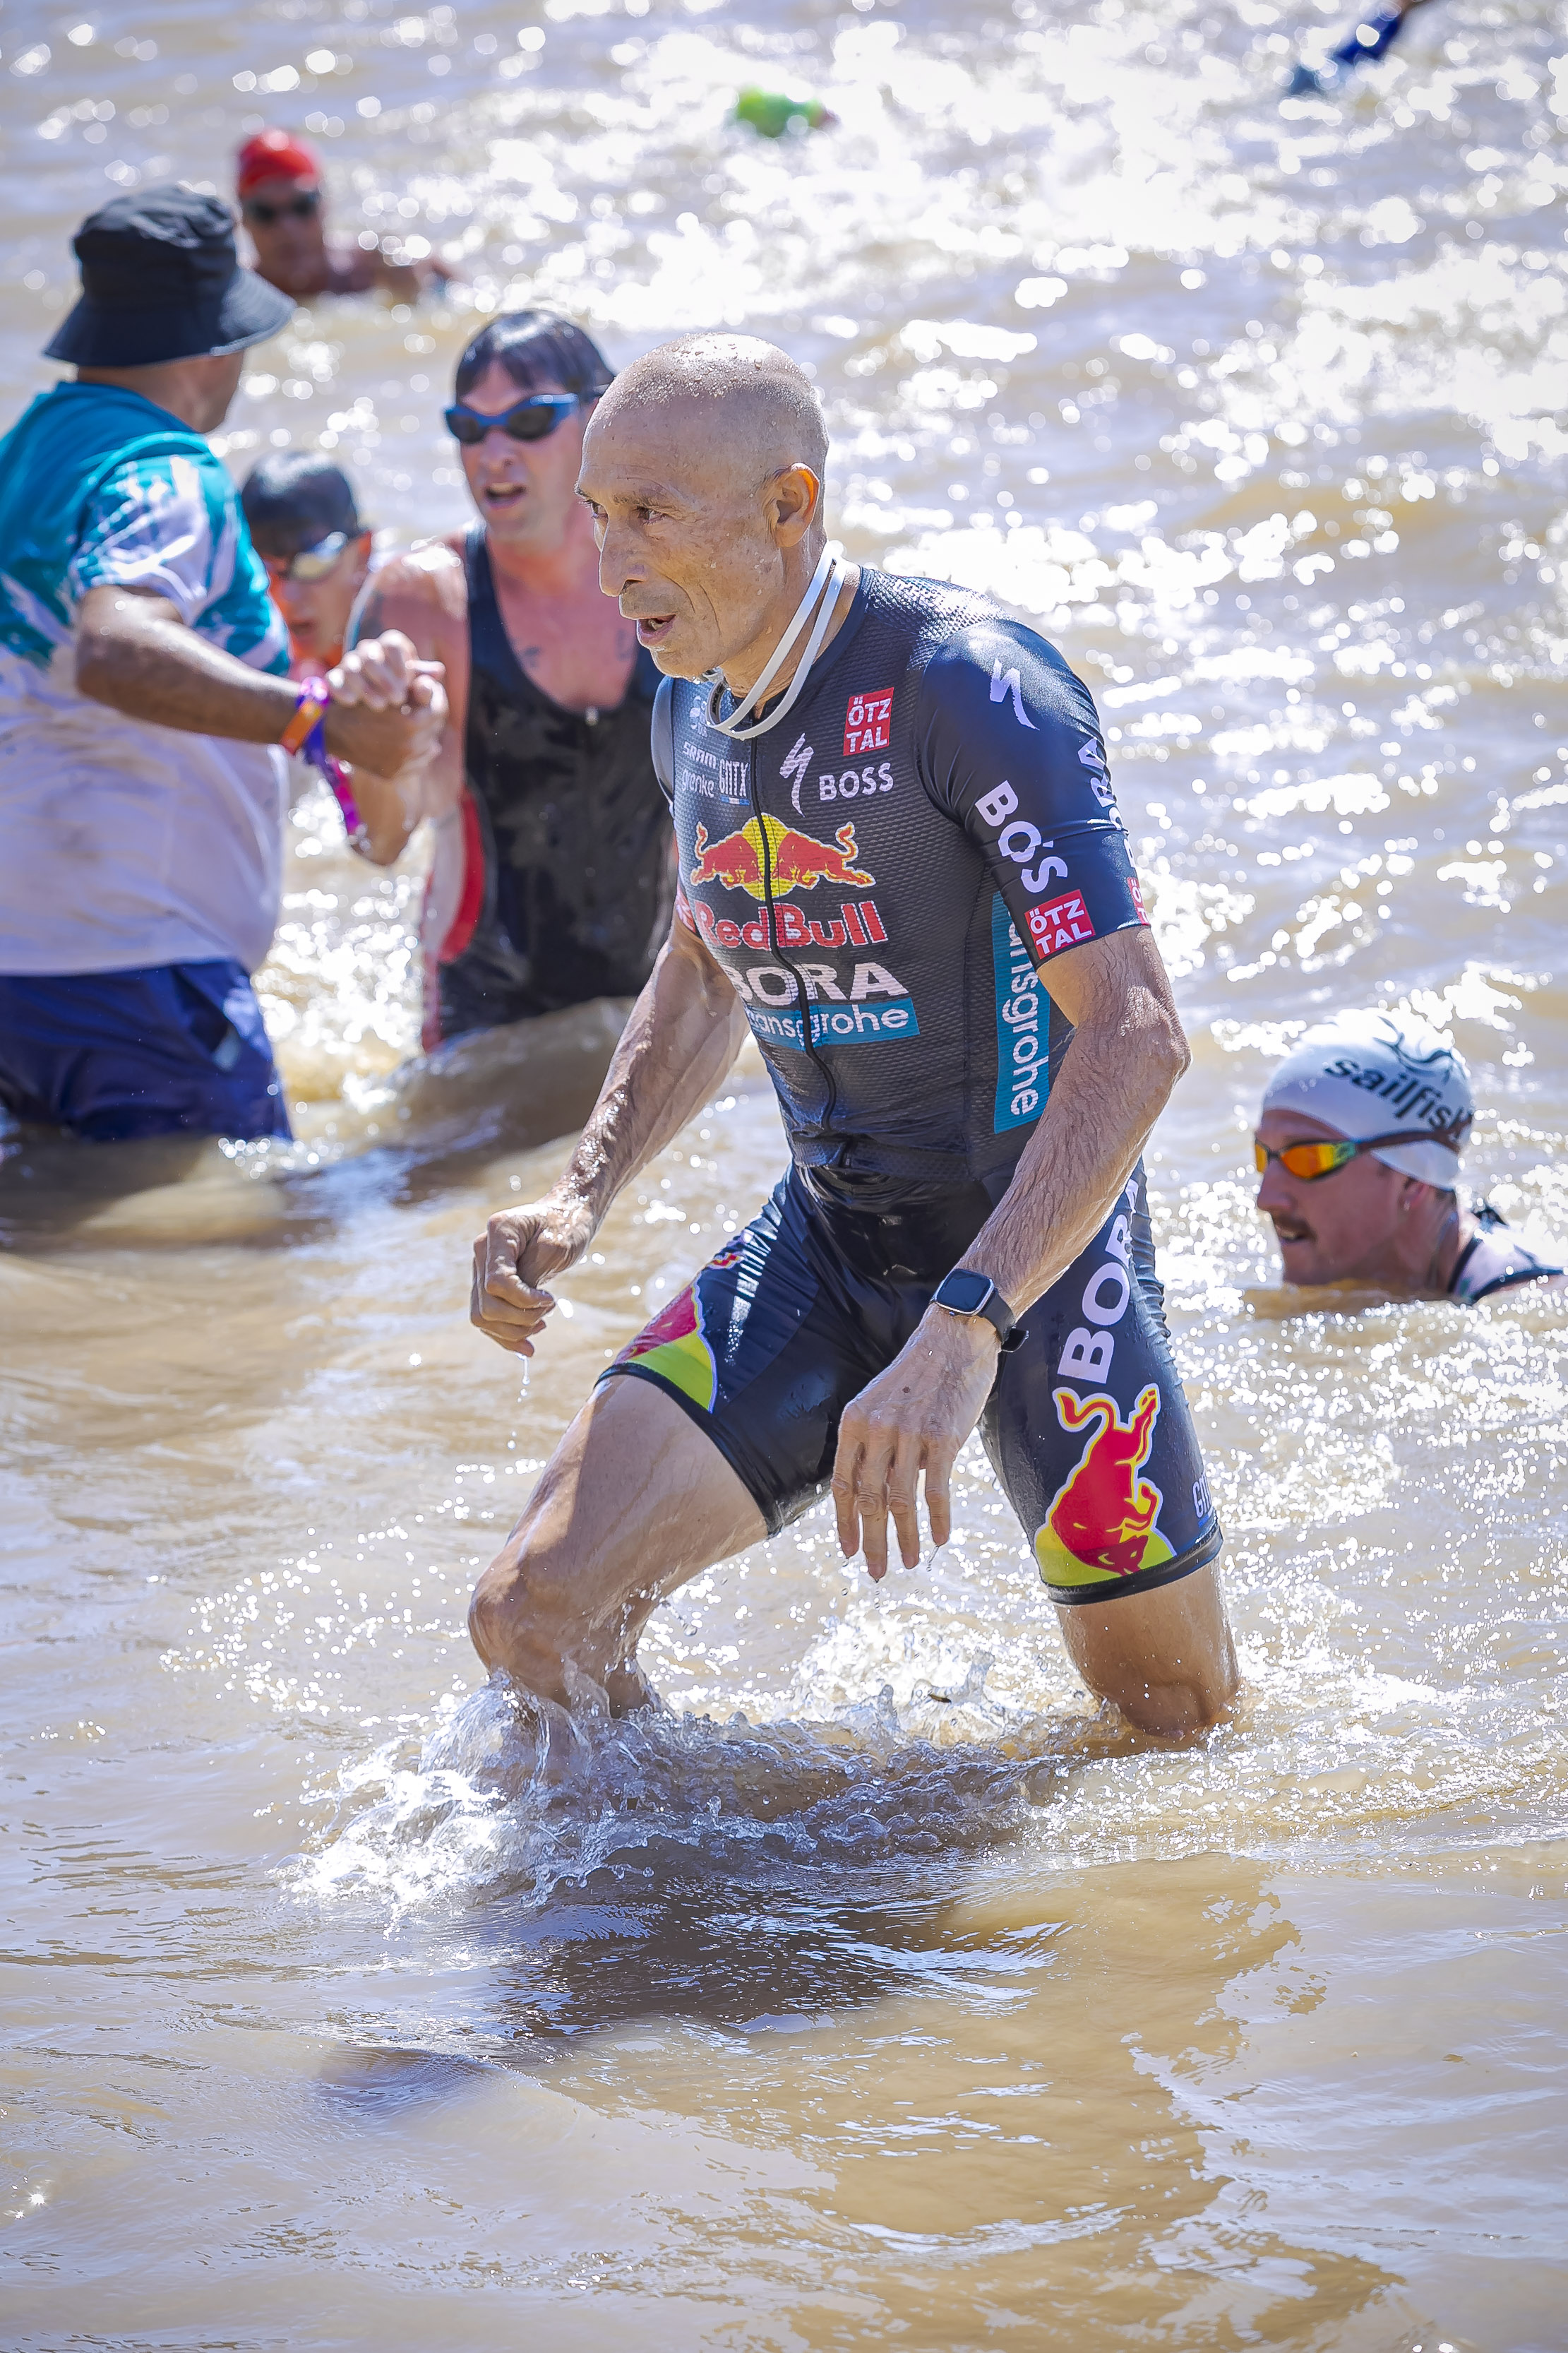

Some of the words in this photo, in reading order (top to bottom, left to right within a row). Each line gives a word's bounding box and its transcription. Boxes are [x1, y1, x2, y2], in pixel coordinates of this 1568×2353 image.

[849, 696, 891, 727] ÖTZ
[683, 741, 717, 770] SRAM
[846, 728, 888, 753] TAL
[819, 763, 894, 802] BOSS
[974, 780, 1068, 893] BOS
[695, 900, 772, 951] Red
[773, 900, 889, 948] Bull
[1029, 898, 1085, 935] ÖTZ
[1036, 922, 1093, 955] TAL
[722, 962, 909, 1006] BORA
[1002, 910, 1050, 1116] ansgrohe
